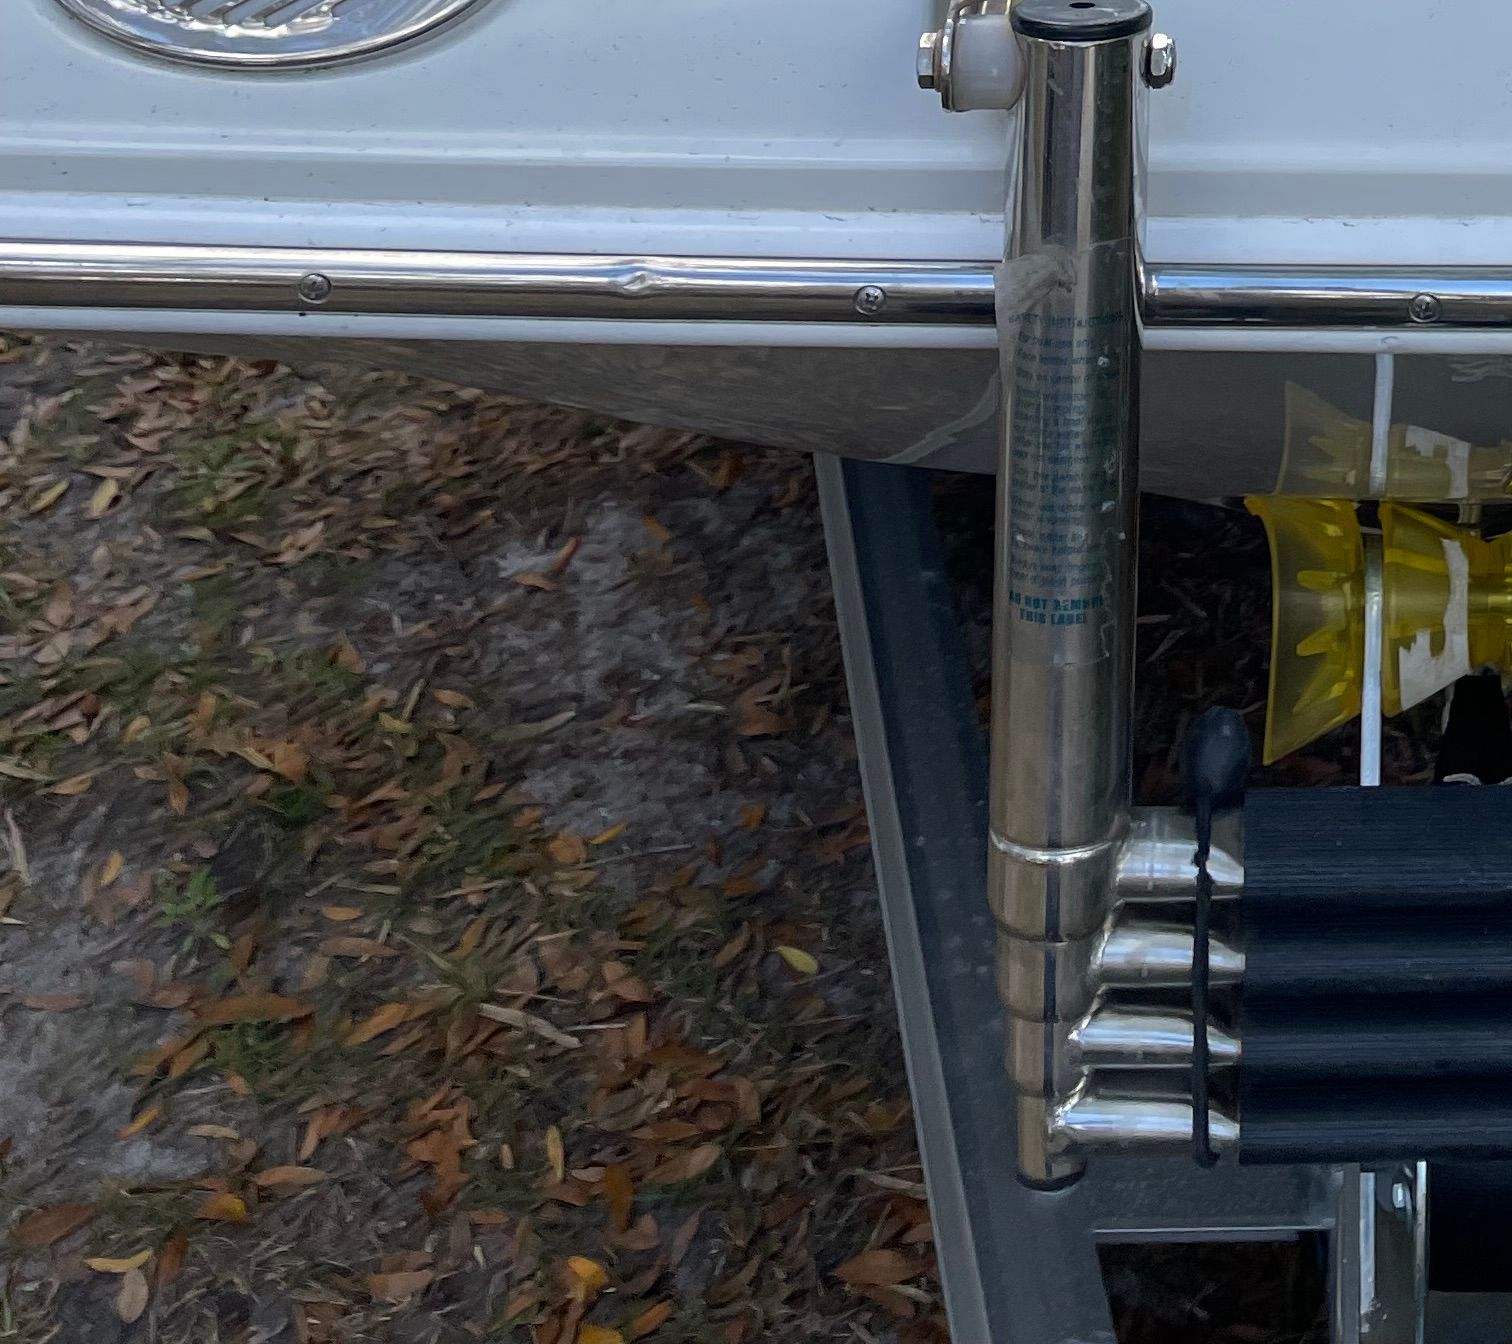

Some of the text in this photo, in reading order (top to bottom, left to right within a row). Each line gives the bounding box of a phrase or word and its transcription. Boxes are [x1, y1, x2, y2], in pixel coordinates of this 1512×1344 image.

[1025, 595, 1047, 610] NOT
[1053, 595, 1103, 611] REMOVE
[1019, 608, 1087, 625] THIS LABEL
